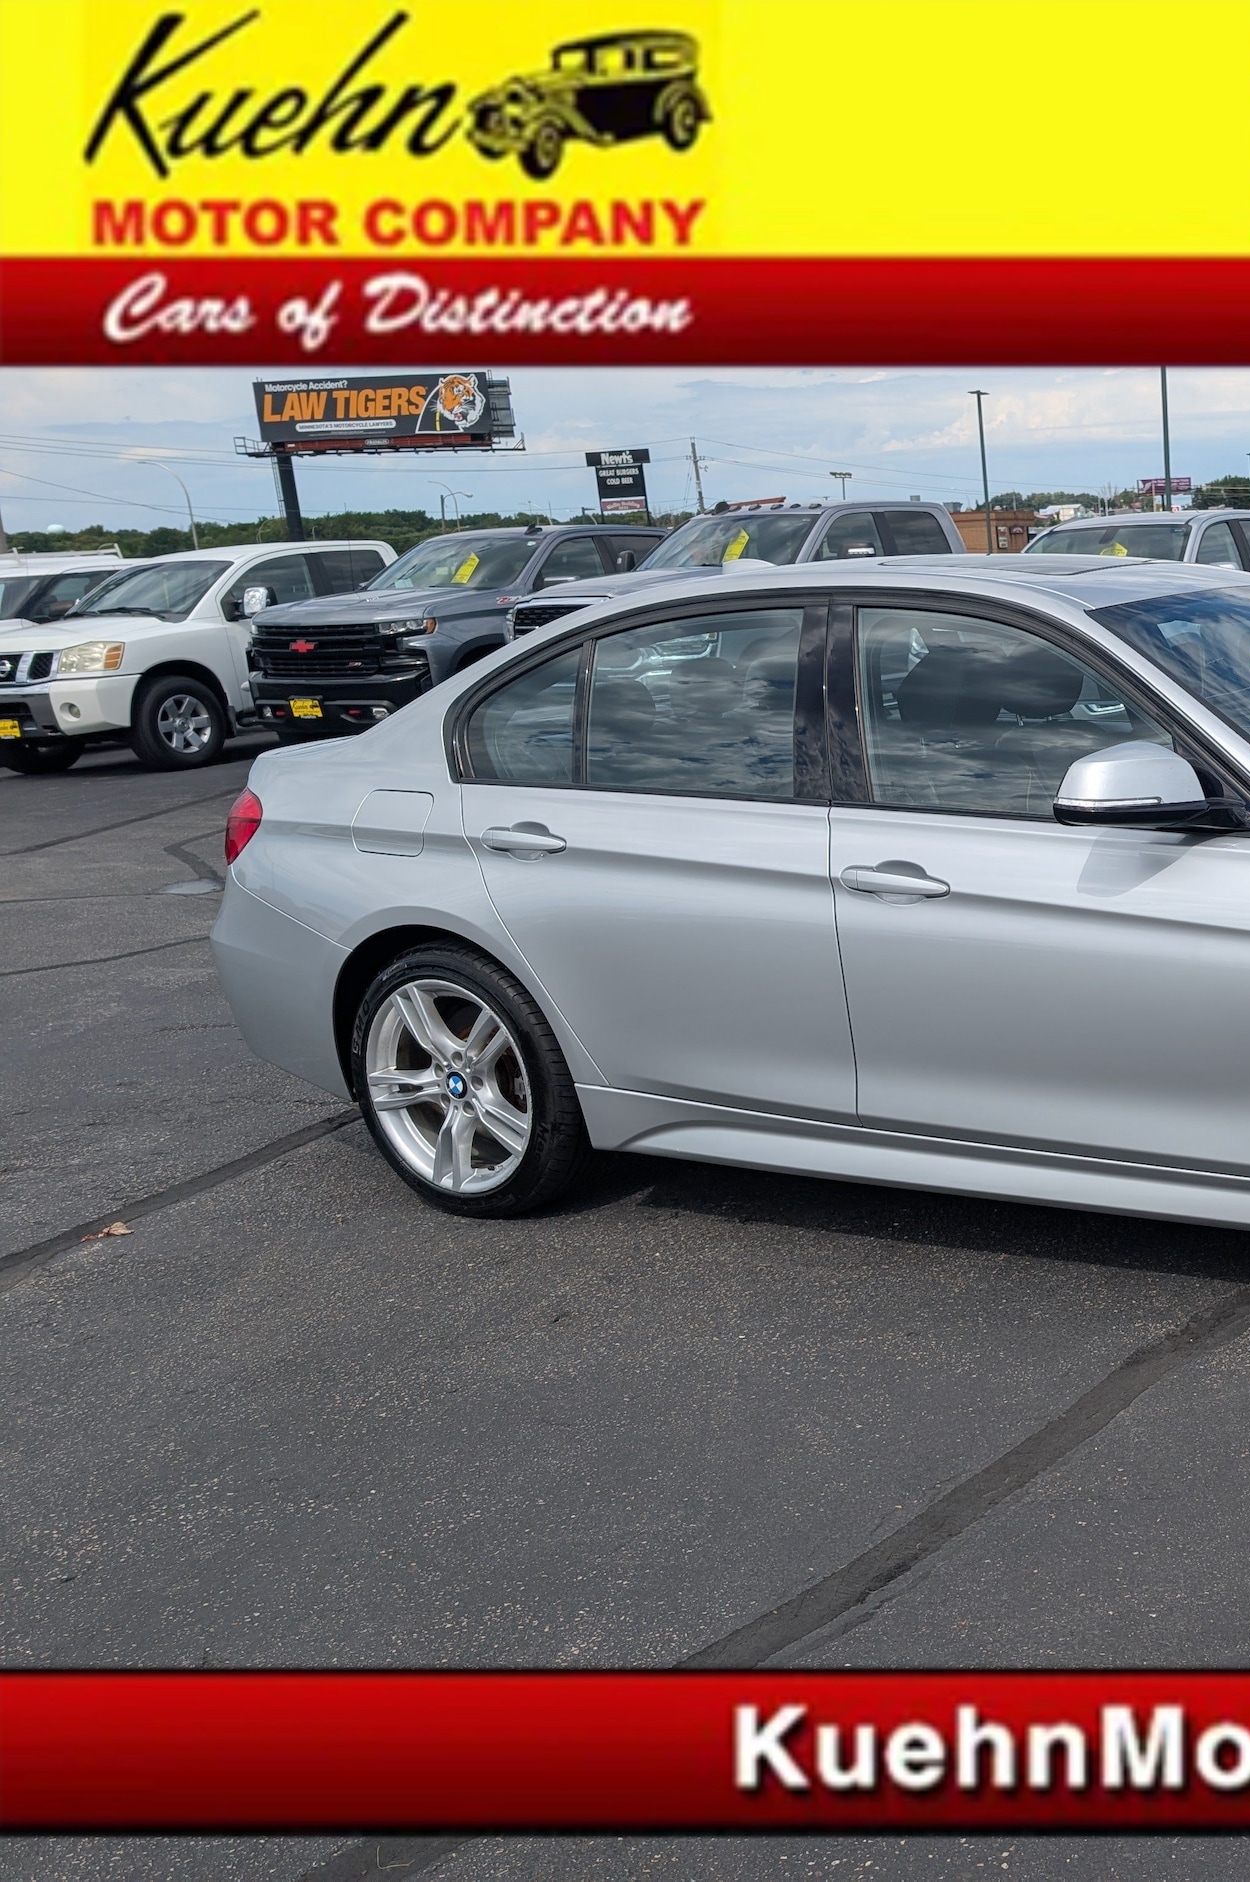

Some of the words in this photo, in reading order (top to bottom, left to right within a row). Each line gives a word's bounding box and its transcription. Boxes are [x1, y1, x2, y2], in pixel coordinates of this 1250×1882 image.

[264, 382, 308, 393] Motorcycle
[308, 380, 349, 390] Accident?
[263, 391, 328, 423] LAW
[332, 385, 427, 419] TIGERS
[600, 451, 633, 465] Newt's
